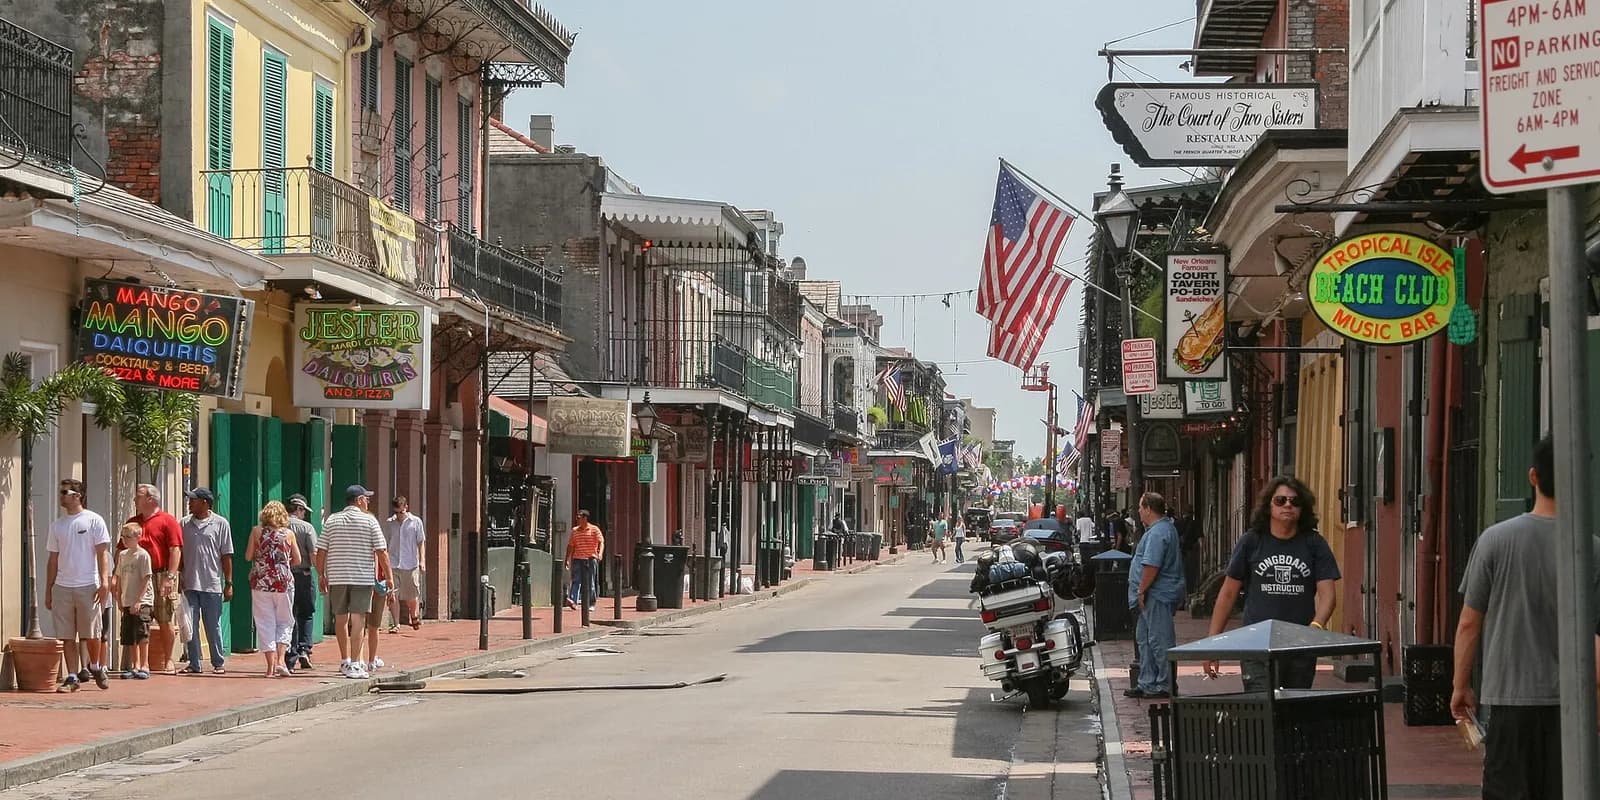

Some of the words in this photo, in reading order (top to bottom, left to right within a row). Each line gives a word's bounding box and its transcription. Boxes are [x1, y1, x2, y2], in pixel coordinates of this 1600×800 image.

[1493, 40, 1517, 66] NO
[1525, 30, 1600, 57] PARKING
[1489, 71, 1529, 92] FREIGHT
[1536, 67, 1557, 86] AND
[1169, 92, 1211, 100] FAMOUS
[1216, 91, 1277, 100] HISTORICAL
[1532, 89, 1562, 108] ZONE
[1142, 101, 1174, 132] The
[1178, 103, 1212, 127] Court
[1213, 107, 1231, 132] of
[1230, 102, 1262, 132] Two
[1264, 101, 1304, 128] Sisters
[1323, 236, 1412, 271] TROPICAL
[1417, 244, 1455, 276] ISLE
[1170, 280, 1220, 288] TAVERN
[1173, 272, 1217, 280] COURT
[116, 287, 200, 313] MANGO
[1170, 288, 1220, 296] PO-BOY
[1315, 272, 1384, 304] BEACH
[1395, 273, 1450, 306] CLUB
[85, 300, 229, 346] MANGO
[300, 308, 422, 344] JESTER
[1332, 308, 1391, 340] MUSIC
[1400, 311, 1440, 338] BAR
[93, 332, 217, 364] DAIQUIRIS
[331, 340, 361, 351] MARDI
[364, 338, 393, 346] GRAS
[95, 353, 160, 371] COCKTAILS
[165, 361, 174, 372] &
[179, 362, 209, 375] BEER
[303, 360, 417, 388] DAIQUIRIS
[146, 367, 155, 382] &
[159, 374, 201, 389] MORE
[325, 388, 353, 397] AND
[355, 388, 391, 398] PIZZA
[1255, 554, 1311, 578] LONGBOARD
[1261, 583, 1305, 593] INSTRUCTOR
